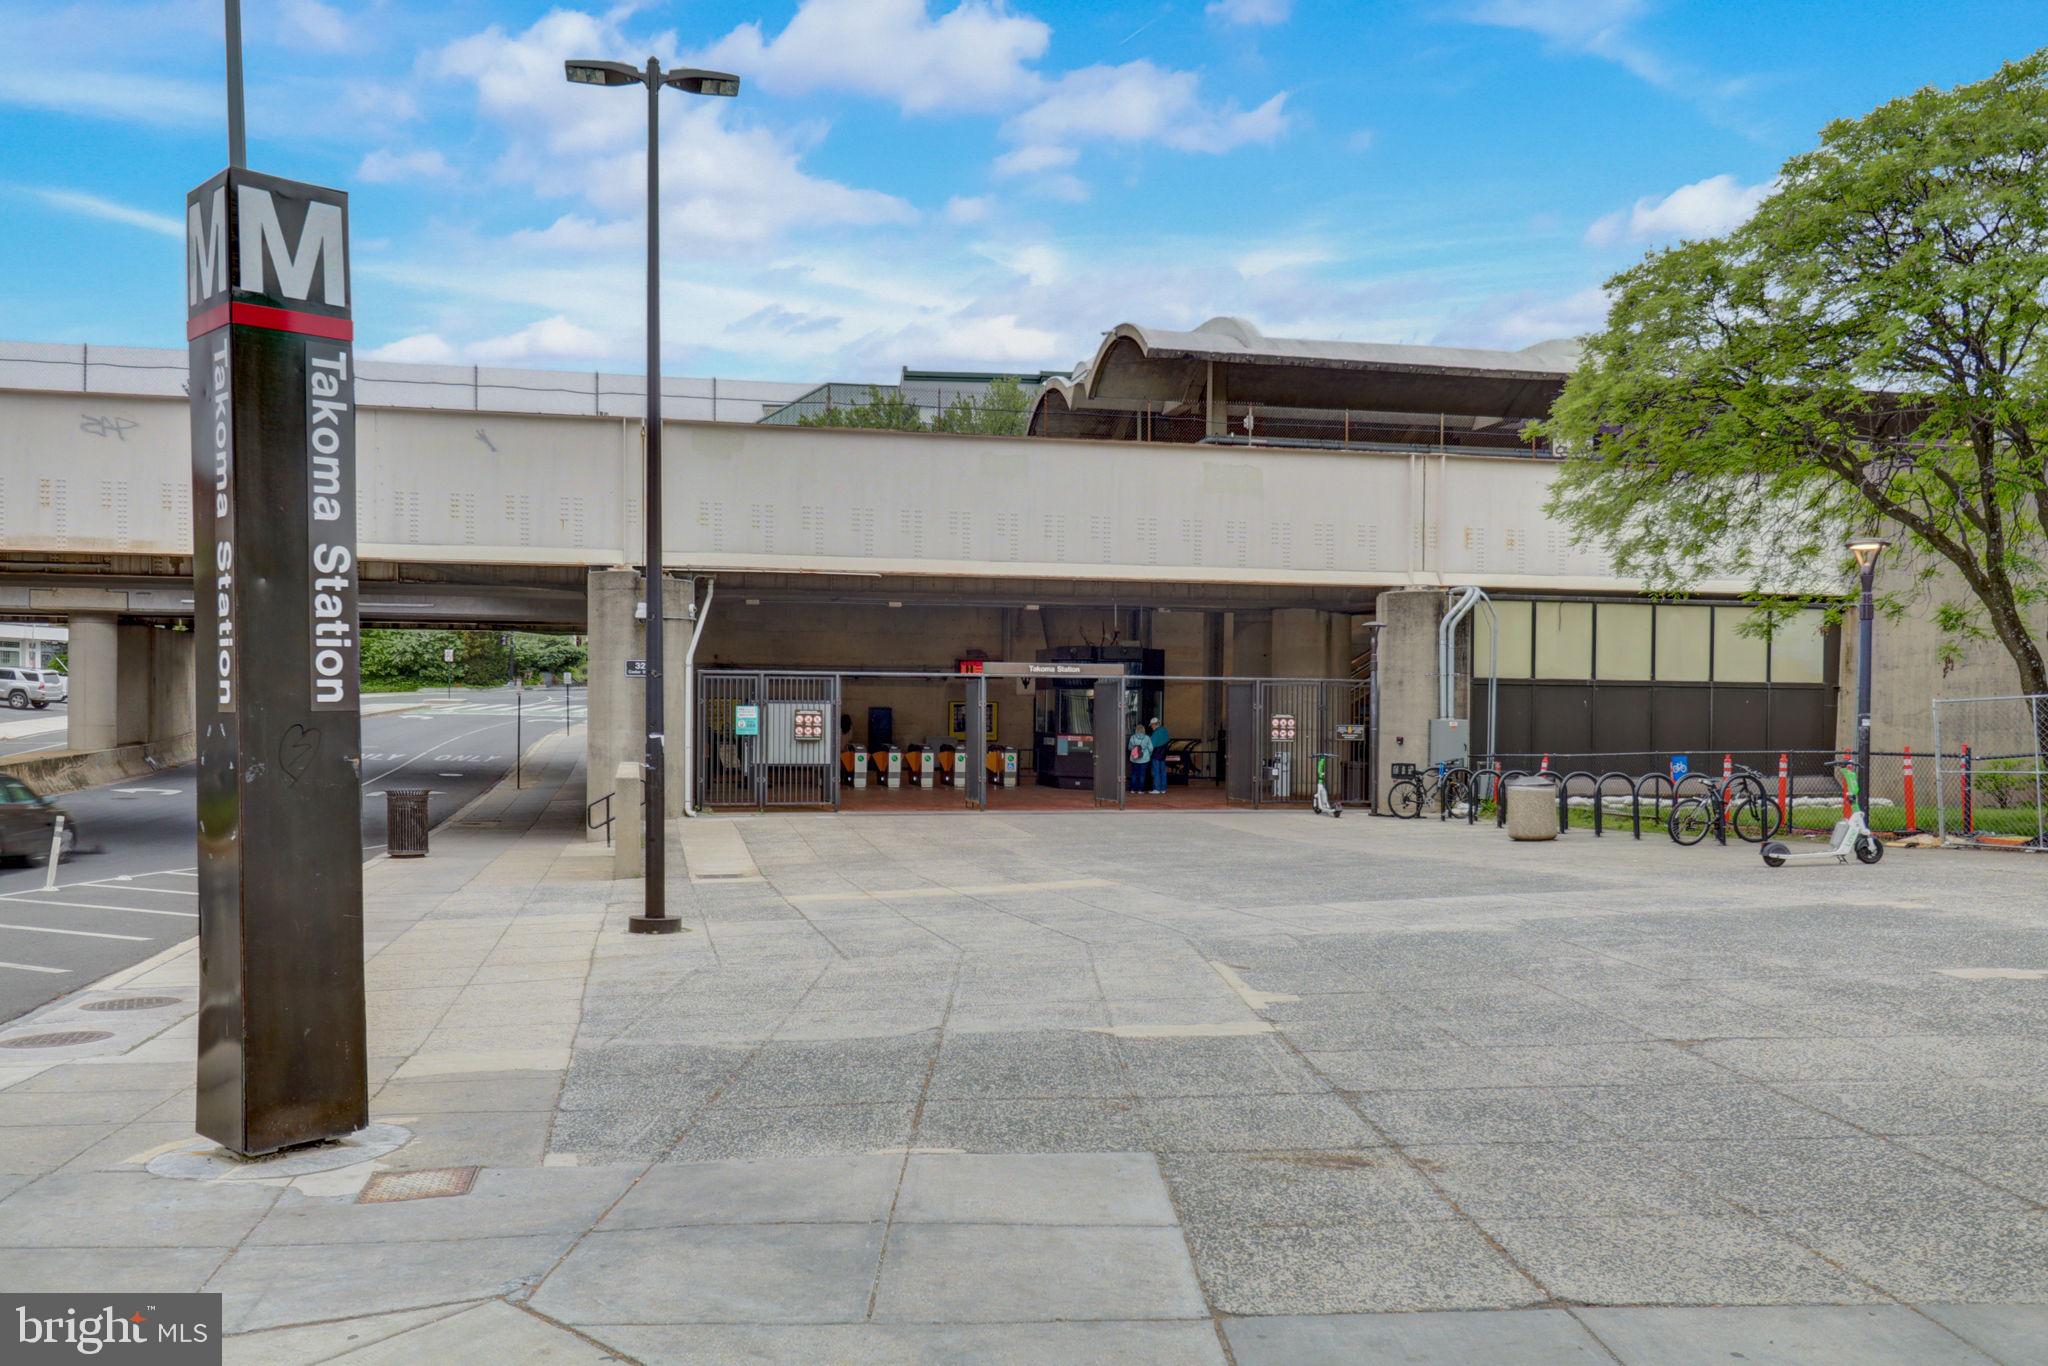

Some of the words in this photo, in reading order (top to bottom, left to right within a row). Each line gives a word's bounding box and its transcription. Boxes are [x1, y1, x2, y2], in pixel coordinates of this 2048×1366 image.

[189, 186, 227, 307] M
[237, 184, 346, 307] M
[212, 338, 229, 519] Takoma
[311, 351, 347, 521] Takoma
[217, 540, 232, 704] Station
[312, 543, 352, 703] Station
[1029, 665, 1055, 673] Takoma
[1057, 665, 1080, 673] Station
[433, 754, 502, 762] ONLY
